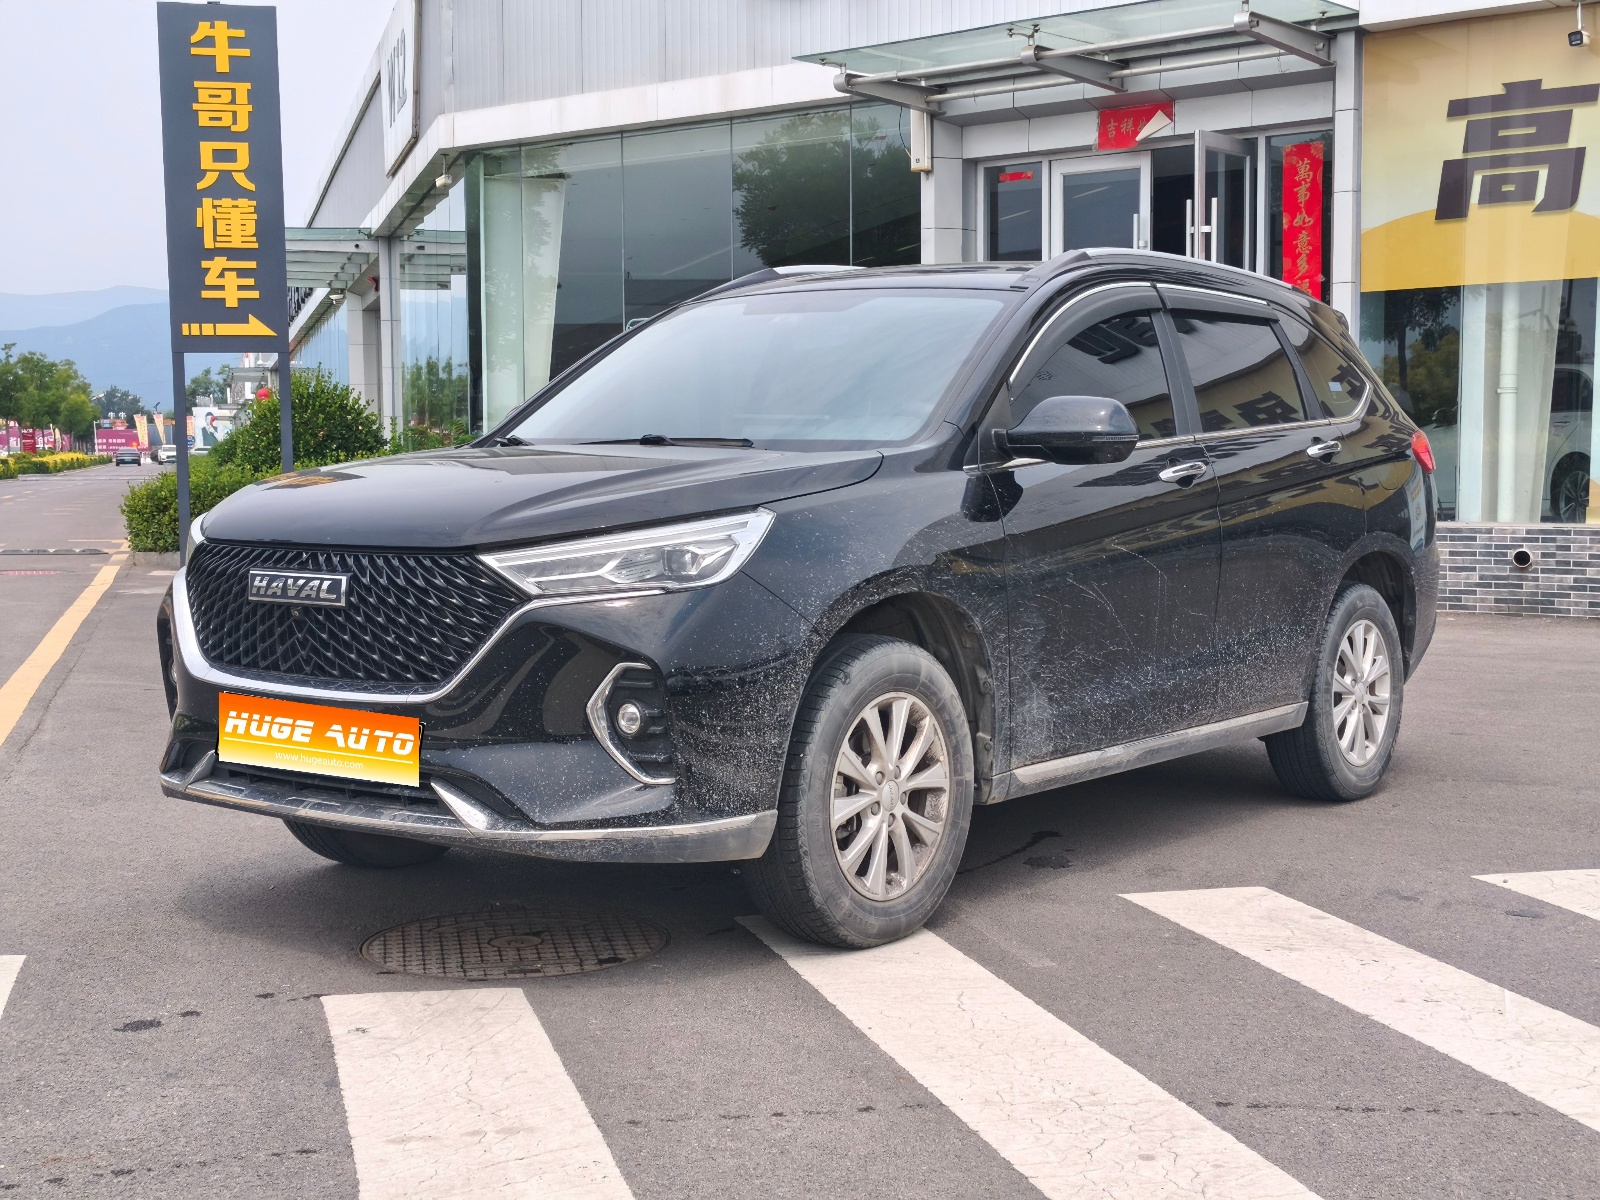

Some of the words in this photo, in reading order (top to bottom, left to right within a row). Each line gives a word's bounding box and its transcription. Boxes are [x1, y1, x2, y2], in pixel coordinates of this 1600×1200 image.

[190, 20, 260, 309] 牛哥只懂车
[1434, 79, 1600, 221] 高
[251, 576, 337, 600] HAVAL
